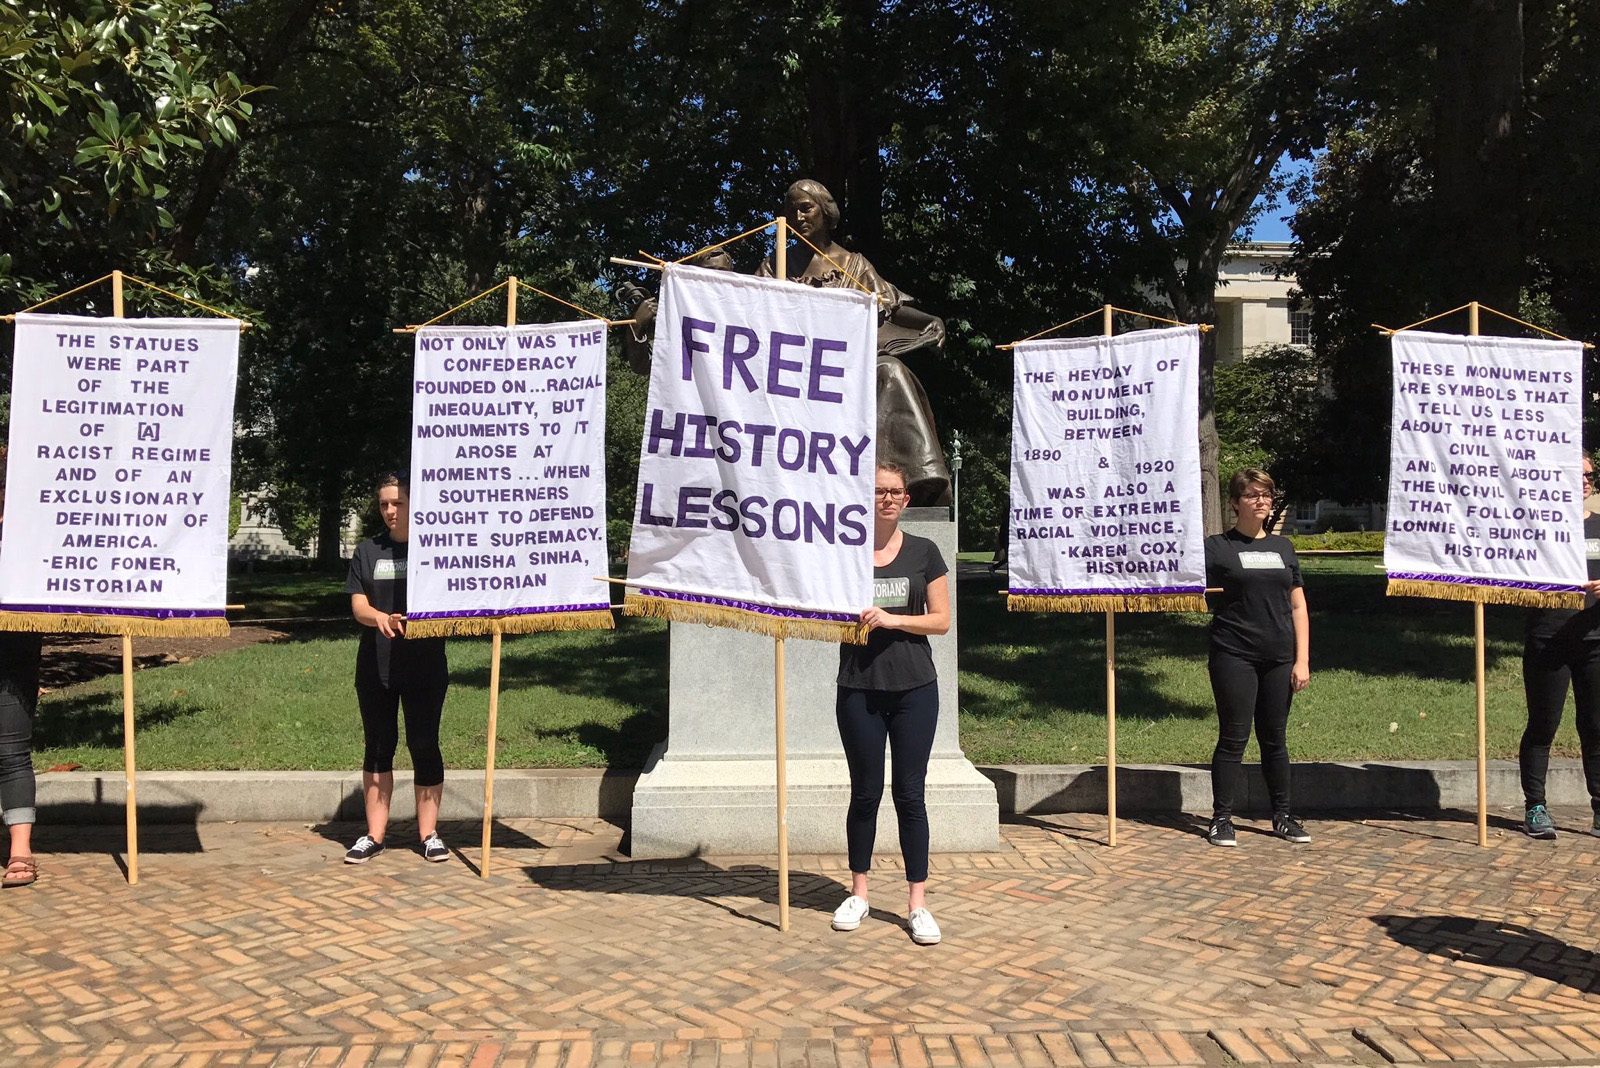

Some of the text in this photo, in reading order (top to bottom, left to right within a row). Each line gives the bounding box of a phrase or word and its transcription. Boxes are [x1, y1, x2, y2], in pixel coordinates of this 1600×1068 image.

[57, 334, 198, 351] THE STATUES
[420, 330, 602, 351] NOT ONLY WAS THE
[67, 356, 189, 373] WERE PART
[444, 356, 577, 372] CONFEDERACY
[681, 316, 848, 404] FREE
[1024, 359, 1179, 383] THE HEYDAY OF
[1400, 362, 1572, 383] THESE MONUMENTS
[78, 379, 169, 394] OF THE
[416, 381, 496, 394] FOUNDED
[1052, 381, 1153, 403] MONUMENT
[1438, 385, 1516, 401] SYMBOLS
[1525, 390, 1569, 403] THAT
[43, 400, 183, 417] LEGITIMATION
[429, 398, 584, 419] INEQUALITY, BUT
[1067, 403, 1145, 423] BUILDING,
[1419, 402, 1544, 422] TELL US LESS
[80, 422, 160, 441] OF [A]
[418, 421, 588, 438] MONUMENTS TO IT
[1065, 423, 1142, 442] BETWEEN
[1462, 424, 1496, 437] THE
[1504, 430, 1571, 443] ACTUAL
[647, 408, 871, 476] HISTORY
[38, 446, 210, 461] RACIST REGIME
[456, 445, 553, 458] AROSE AT
[1449, 444, 1535, 460] CIVIL WAR
[1024, 448, 1174, 474] 1890 & 1920
[56, 468, 191, 483] AND OF AN
[1406, 461, 1561, 481] AND MORE ABOUT
[40, 490, 203, 505] EXCLUSIONARY
[439, 486, 568, 503] SOUTHERNERS
[1047, 481, 1174, 499] WAS ALSO A
[1401, 480, 1572, 503] THE UNCIVIL PEACE
[414, 506, 593, 525] SOUGHT TO DEFEND
[639, 483, 868, 546] LESSONS
[1014, 500, 1180, 520] TIME OF EXTREME
[1409, 500, 1568, 524] THAT FOLLOWED.
[56, 512, 208, 527] DEFINITION OF
[419, 528, 602, 547] WHITE SUPREMACY.
[1017, 522, 1182, 540] RACIAL VIOLENCE.
[1393, 521, 1455, 534] LONNIE
[1489, 528, 1545, 540] BUNCH
[1555, 531, 1570, 543] III
[62, 534, 157, 549] AMERICA.
[1141, 541, 1184, 557] COX,
[529, 550, 588, 566] SINHA,
[1445, 544, 1538, 562] HISTORIAN
[111, 557, 180, 574] FONER,
[1087, 559, 1178, 575] HISTORIAN
[47, 578, 162, 593] HISTORIAN
[448, 573, 546, 591] HISTORIAN
